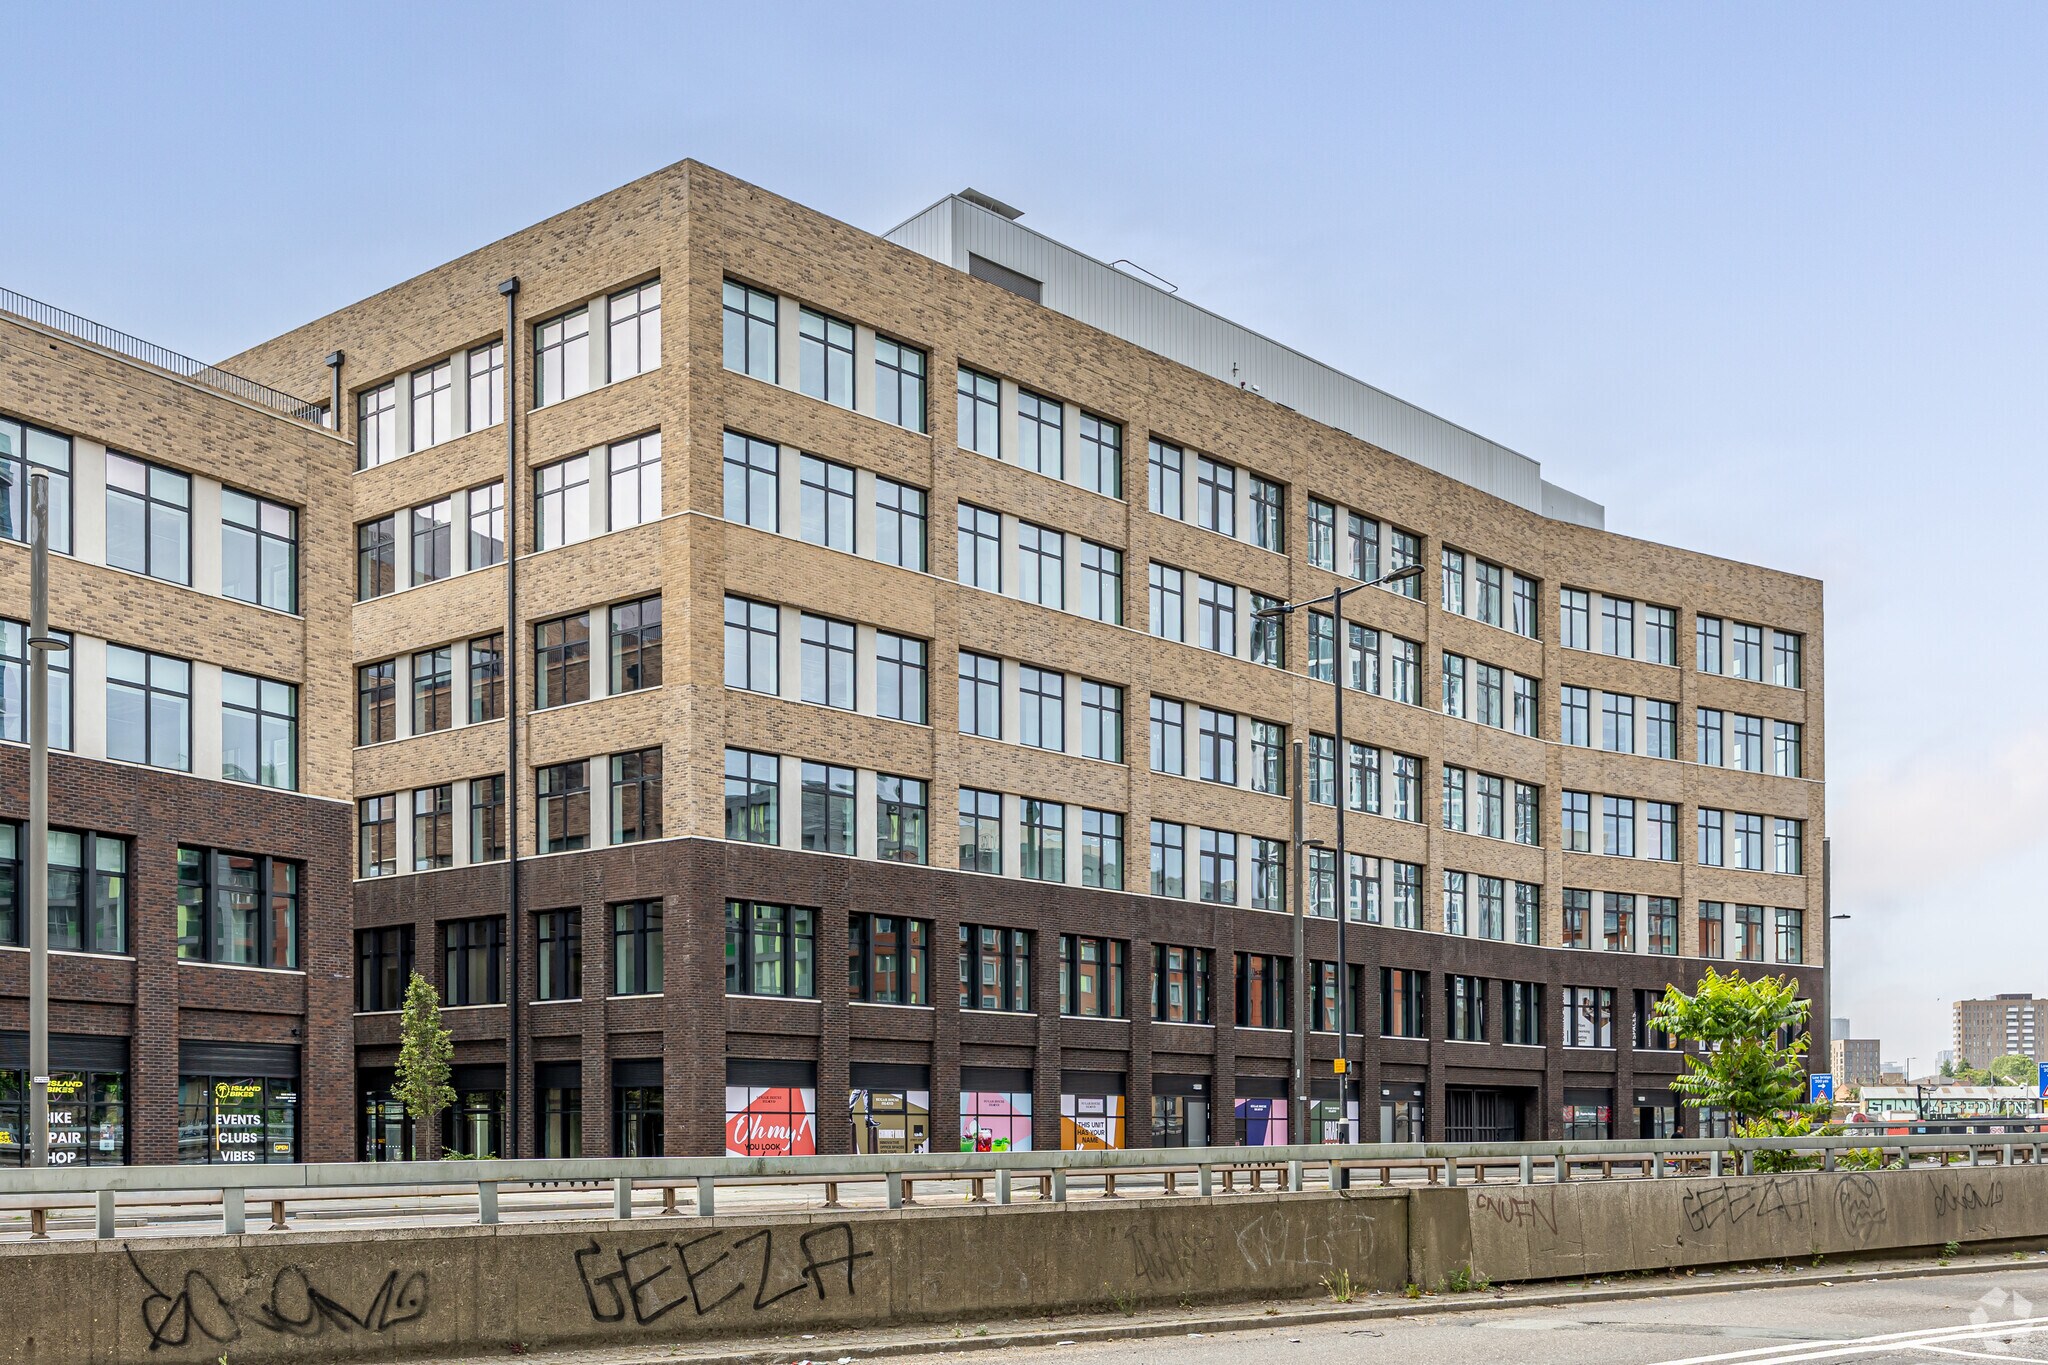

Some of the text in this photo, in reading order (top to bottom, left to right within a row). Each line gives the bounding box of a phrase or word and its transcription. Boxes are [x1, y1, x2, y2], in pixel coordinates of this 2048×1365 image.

[48, 1112, 72, 1123] IKE
[216, 1114, 261, 1125] EVENTS
[219, 1132, 258, 1143] CLUBS
[734, 1114, 808, 1151] Oh my!
[744, 1143, 781, 1151] YOU LOOK
[48, 1151, 77, 1163] HOP
[220, 1150, 256, 1162] VIBES
[574, 1222, 874, 1325] GEEZA
